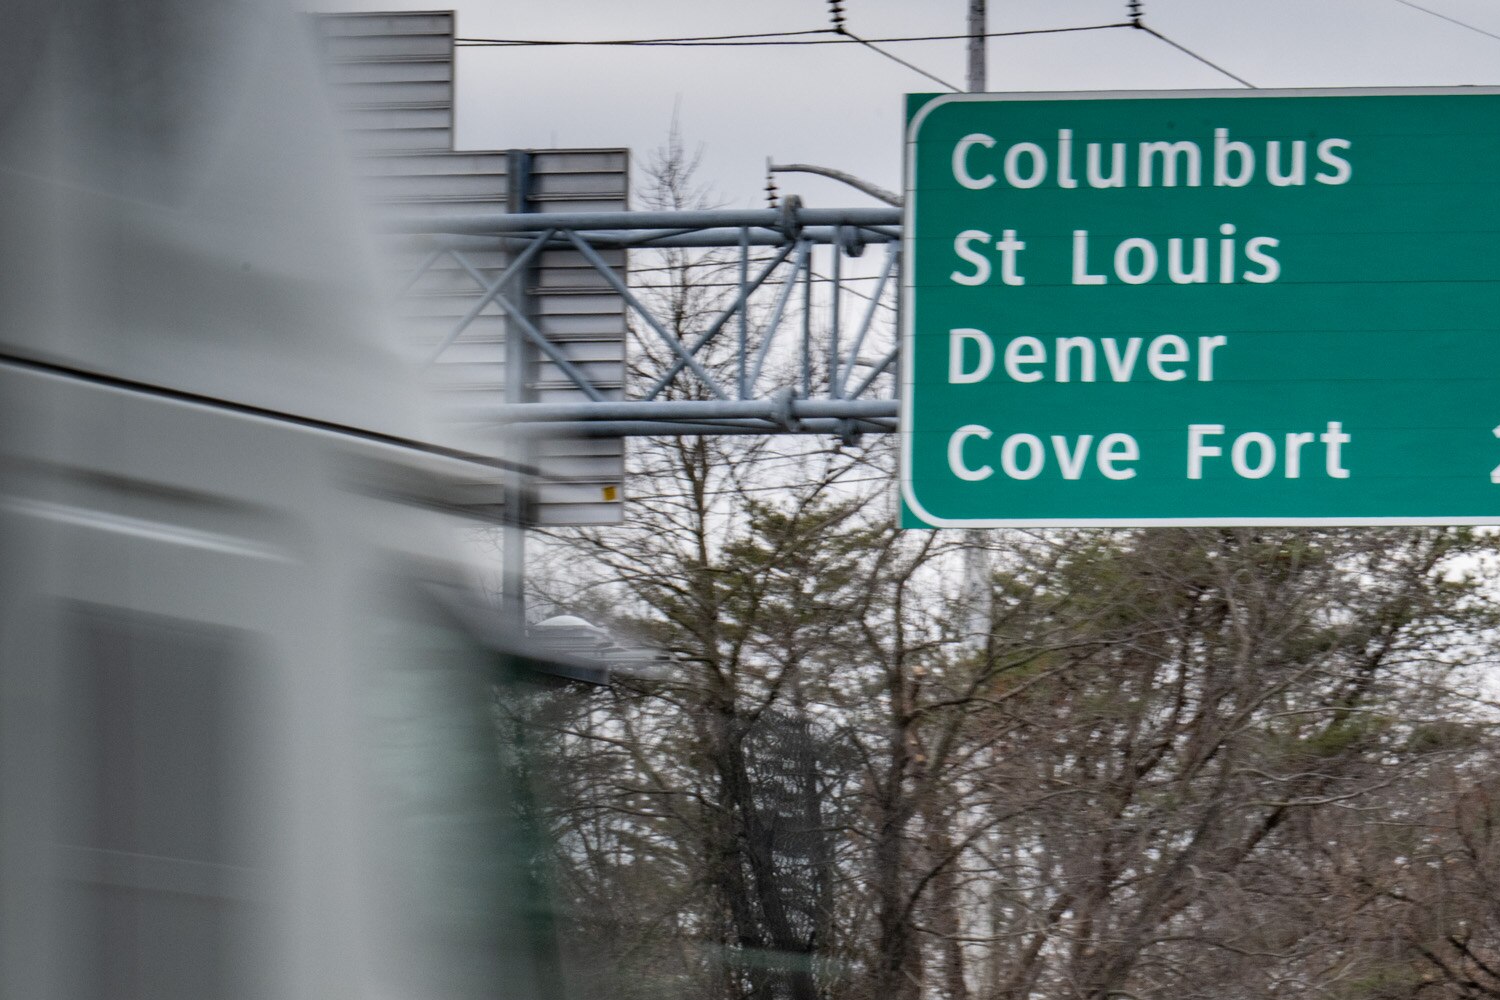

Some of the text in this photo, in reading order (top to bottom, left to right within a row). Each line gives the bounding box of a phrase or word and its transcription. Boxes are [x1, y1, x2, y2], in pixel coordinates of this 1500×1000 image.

[952, 128, 1350, 189] Columbus
[951, 229, 1025, 286] St
[1073, 224, 1281, 286] Louis
[949, 328, 1226, 384] Denver
[948, 424, 1140, 482] Cove
[1187, 421, 1350, 481] Fort
